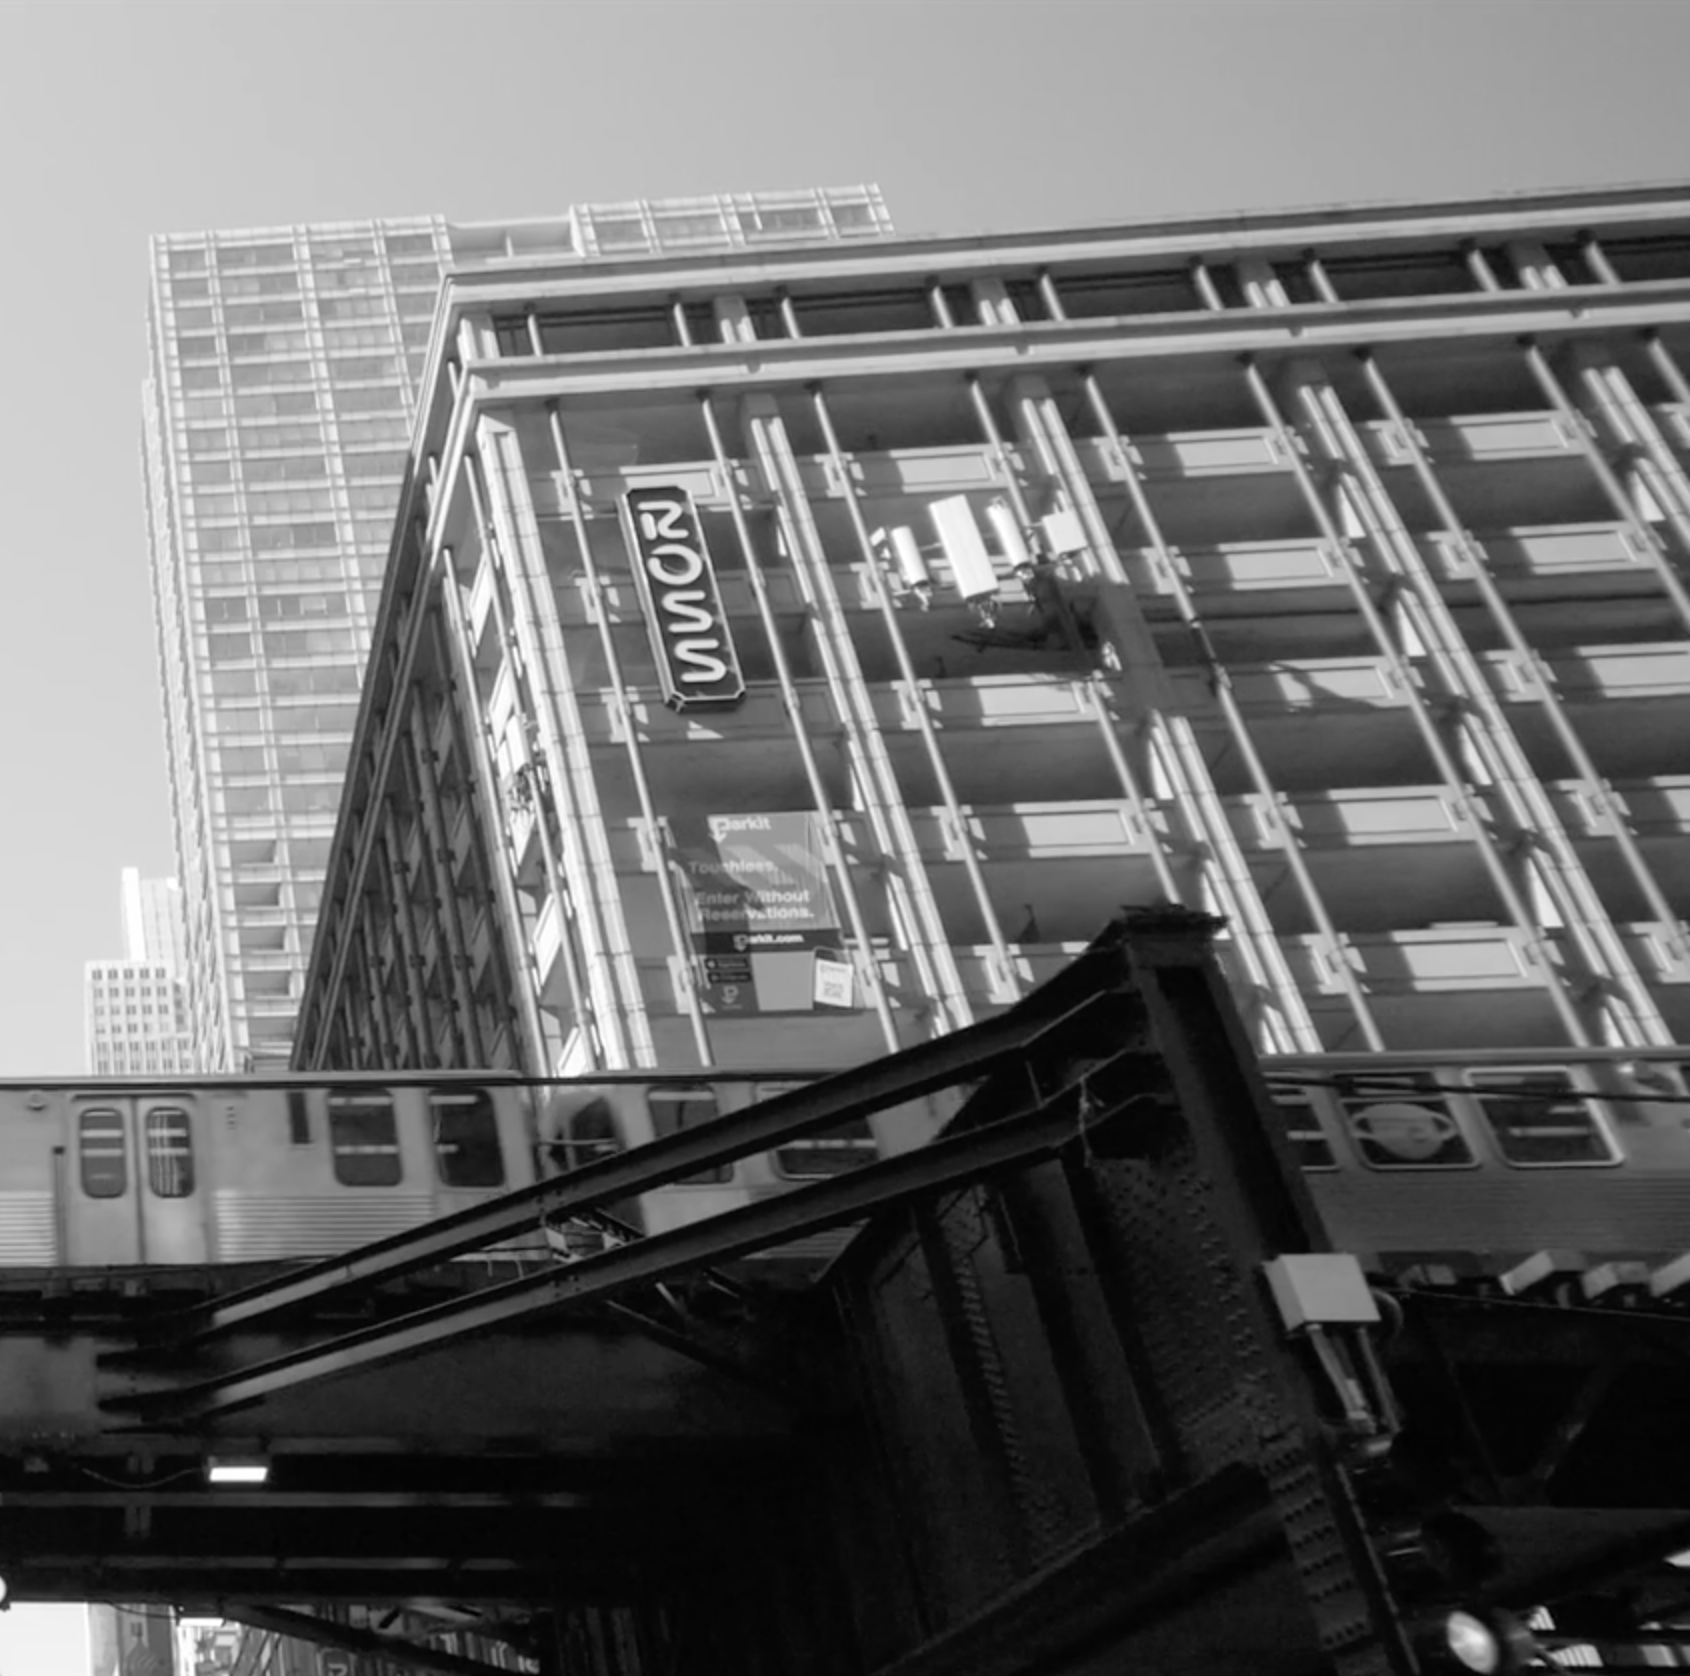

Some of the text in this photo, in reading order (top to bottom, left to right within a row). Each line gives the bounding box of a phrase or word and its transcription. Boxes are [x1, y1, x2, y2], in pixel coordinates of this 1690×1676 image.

[638, 501, 727, 683] ROSS
[694, 889, 810, 906] Enter Without
